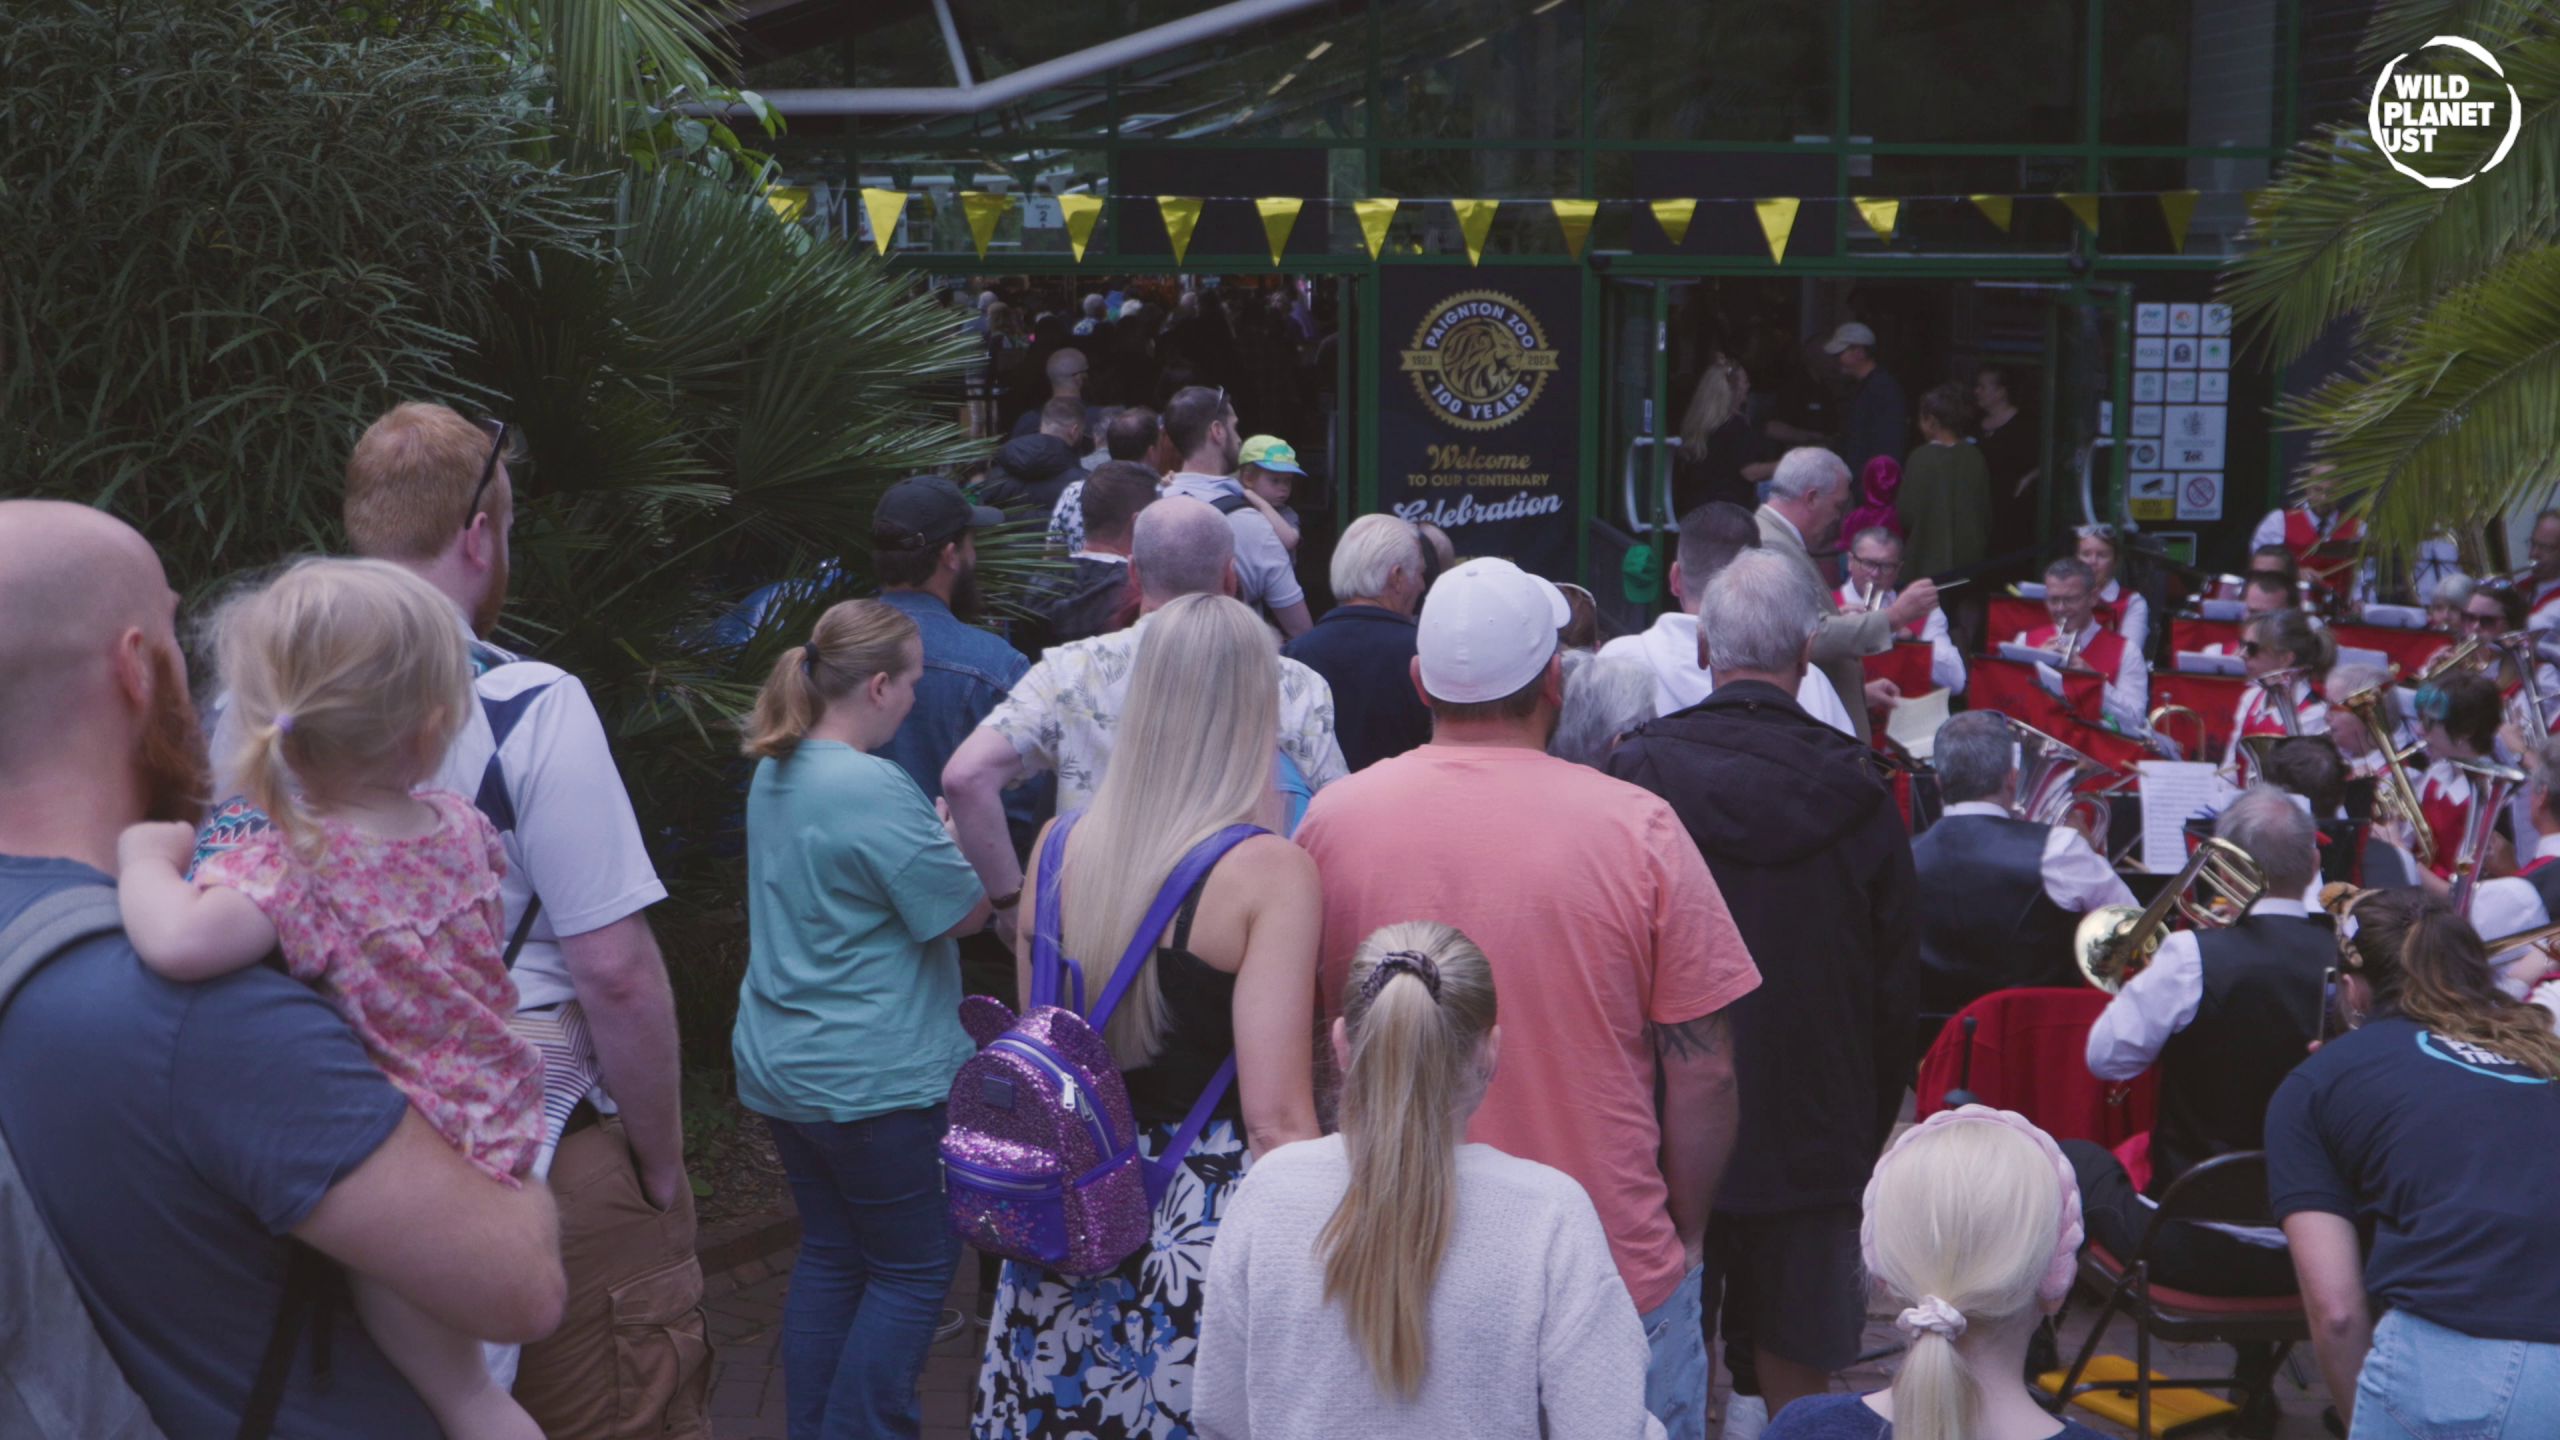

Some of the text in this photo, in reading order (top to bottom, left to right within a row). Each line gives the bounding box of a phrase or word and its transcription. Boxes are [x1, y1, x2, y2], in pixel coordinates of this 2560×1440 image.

[1425, 302, 1535, 348] PAIGNTON ZOO
[1412, 355, 1433, 366] 1923
[1528, 355, 1550, 366] 2023
[1431, 383, 1530, 419] 100 YEARS
[1427, 444, 1532, 470] Welcome
[1408, 474, 1550, 487] TO OUR CENTENARY
